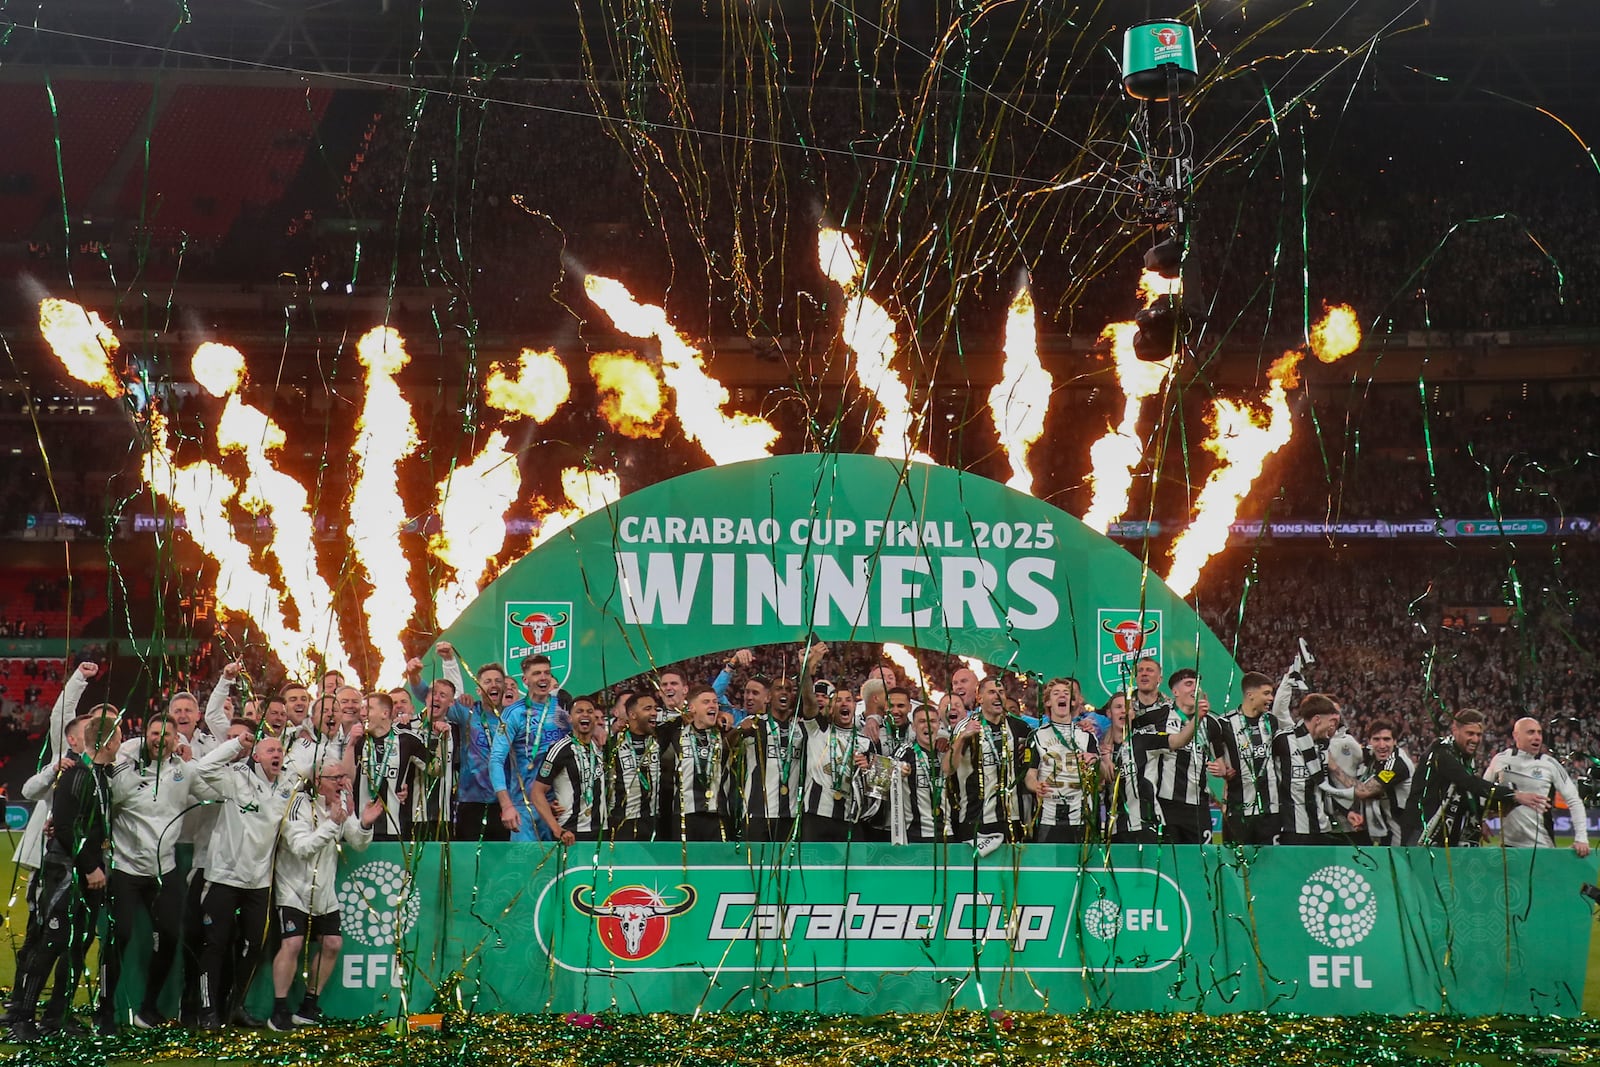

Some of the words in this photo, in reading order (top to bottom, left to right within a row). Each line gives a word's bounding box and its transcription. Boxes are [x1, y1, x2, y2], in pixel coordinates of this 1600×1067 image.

[619, 516, 781, 545] CARABAO
[789, 518, 857, 546] CUP
[864, 520, 963, 547] FINAL
[971, 522, 1055, 549] 2025
[1304, 523, 1383, 533] NEWCASTLE
[1385, 523, 1433, 533] UNITED
[1479, 523, 1512, 531] Caraao
[615, 551, 1060, 630] WINNERS
[509, 639, 567, 660] Carabao
[1103, 647, 1157, 666] Carabao
[707, 893, 943, 940] Carabao
[944, 893, 1056, 952] Cup
[1126, 909, 1169, 931] EFL
[1308, 955, 1373, 988] EFL
